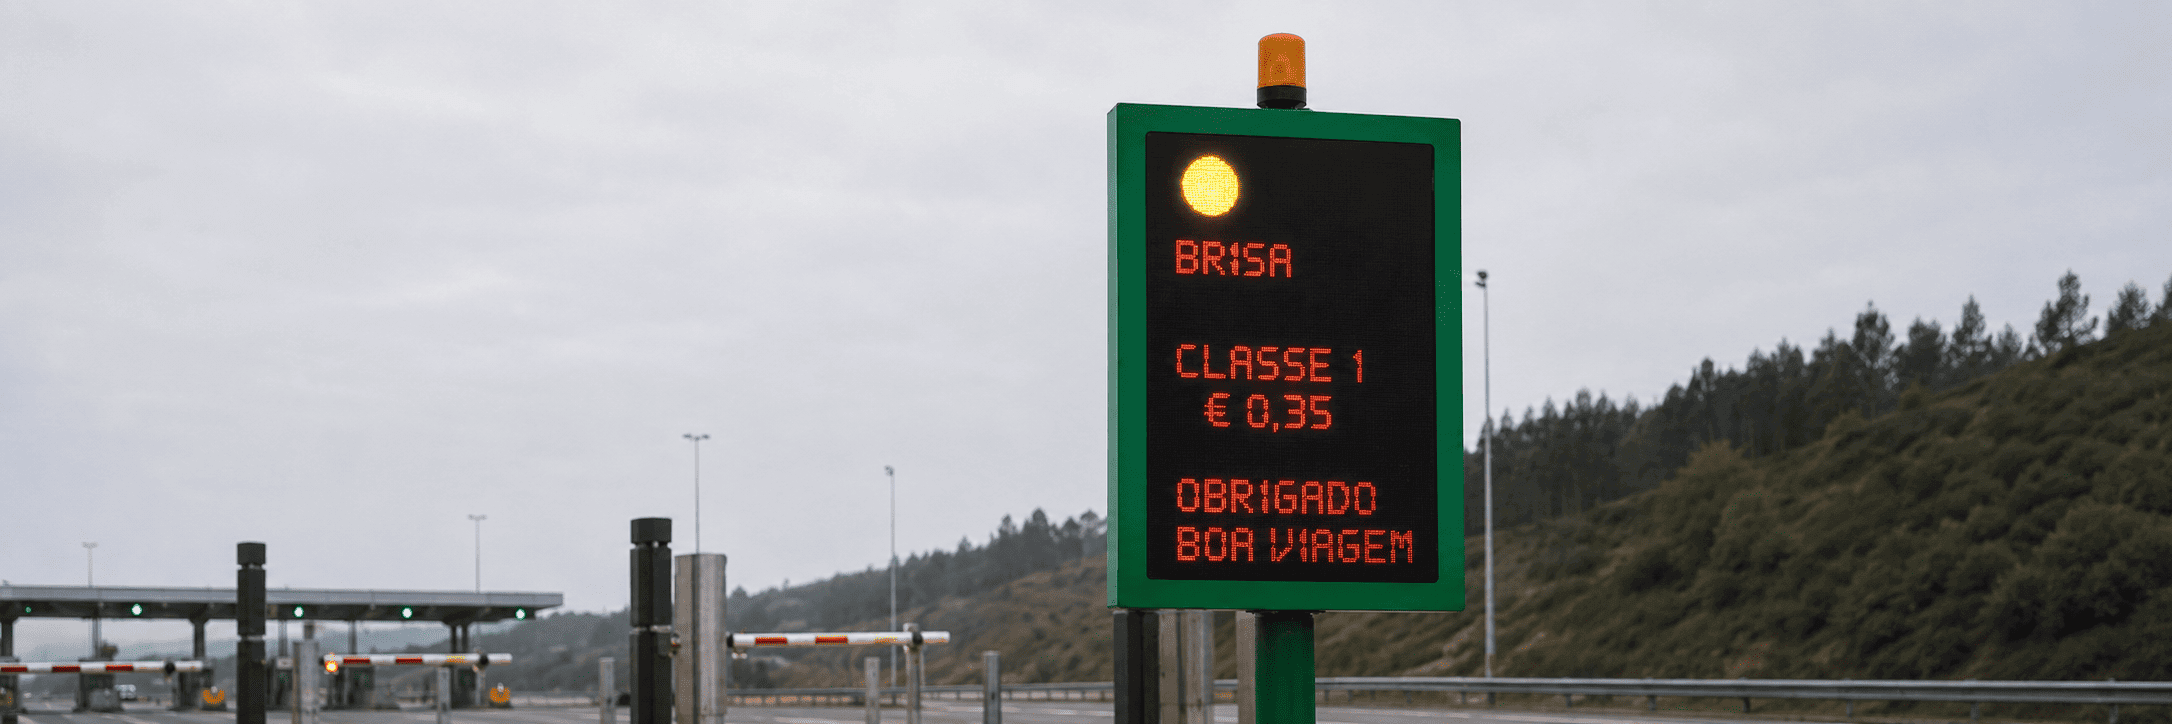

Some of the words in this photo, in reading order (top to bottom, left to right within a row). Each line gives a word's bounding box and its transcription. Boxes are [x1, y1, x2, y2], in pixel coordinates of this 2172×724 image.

[1175, 239, 1292, 278] BRISA
[1176, 343, 1332, 383] CLASSE
[1352, 349, 1363, 384] 1
[1203, 392, 1231, 428] €
[1246, 393, 1332, 433] 0,35
[1176, 477, 1377, 516] OBRIGADO
[1176, 526, 1254, 562] BOA
[1270, 527, 1413, 564] VIAGEM
